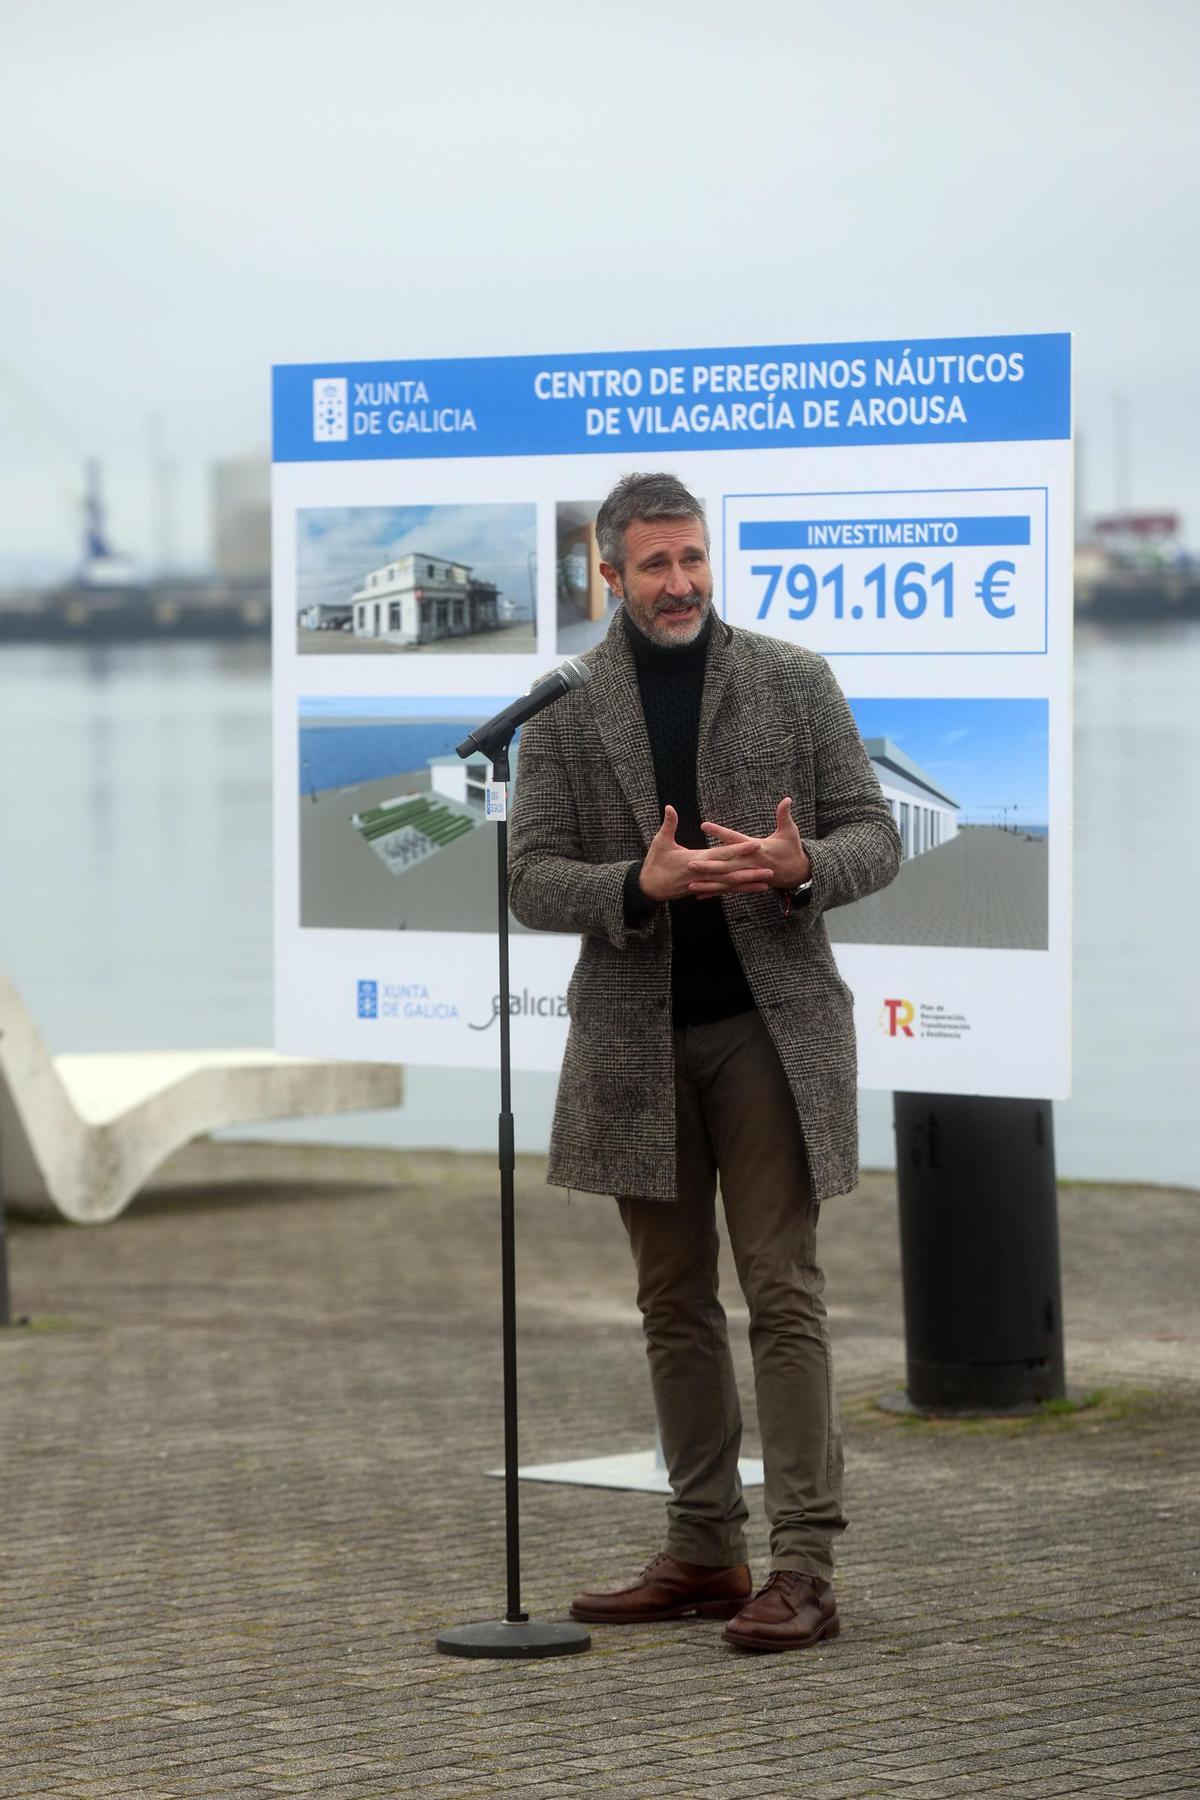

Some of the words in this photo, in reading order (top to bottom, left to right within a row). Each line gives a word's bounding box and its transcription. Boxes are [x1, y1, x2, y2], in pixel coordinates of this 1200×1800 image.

[534, 368, 643, 400] CENTRO
[650, 366, 686, 396] DE
[693, 358, 867, 394] PEREGRINOS
[875, 348, 1025, 387] NÁUTICOS
[354, 381, 430, 406] XUNTA
[353, 411, 382, 435] DE
[387, 408, 477, 434] GALICIA
[586, 407, 621, 436] DE
[627, 393, 796, 434] VILAGARCÍA
[803, 400, 840, 429] DE
[846, 395, 968, 427] AROUSA
[807, 522, 959, 546] INVESTIMENTO
[750, 561, 954, 621] 791.161
[974, 560, 1016, 619] €
[383, 984, 429, 1000] XUNTA
[383, 1002, 399, 1017] DE
[404, 1002, 459, 1018] GALICIA
